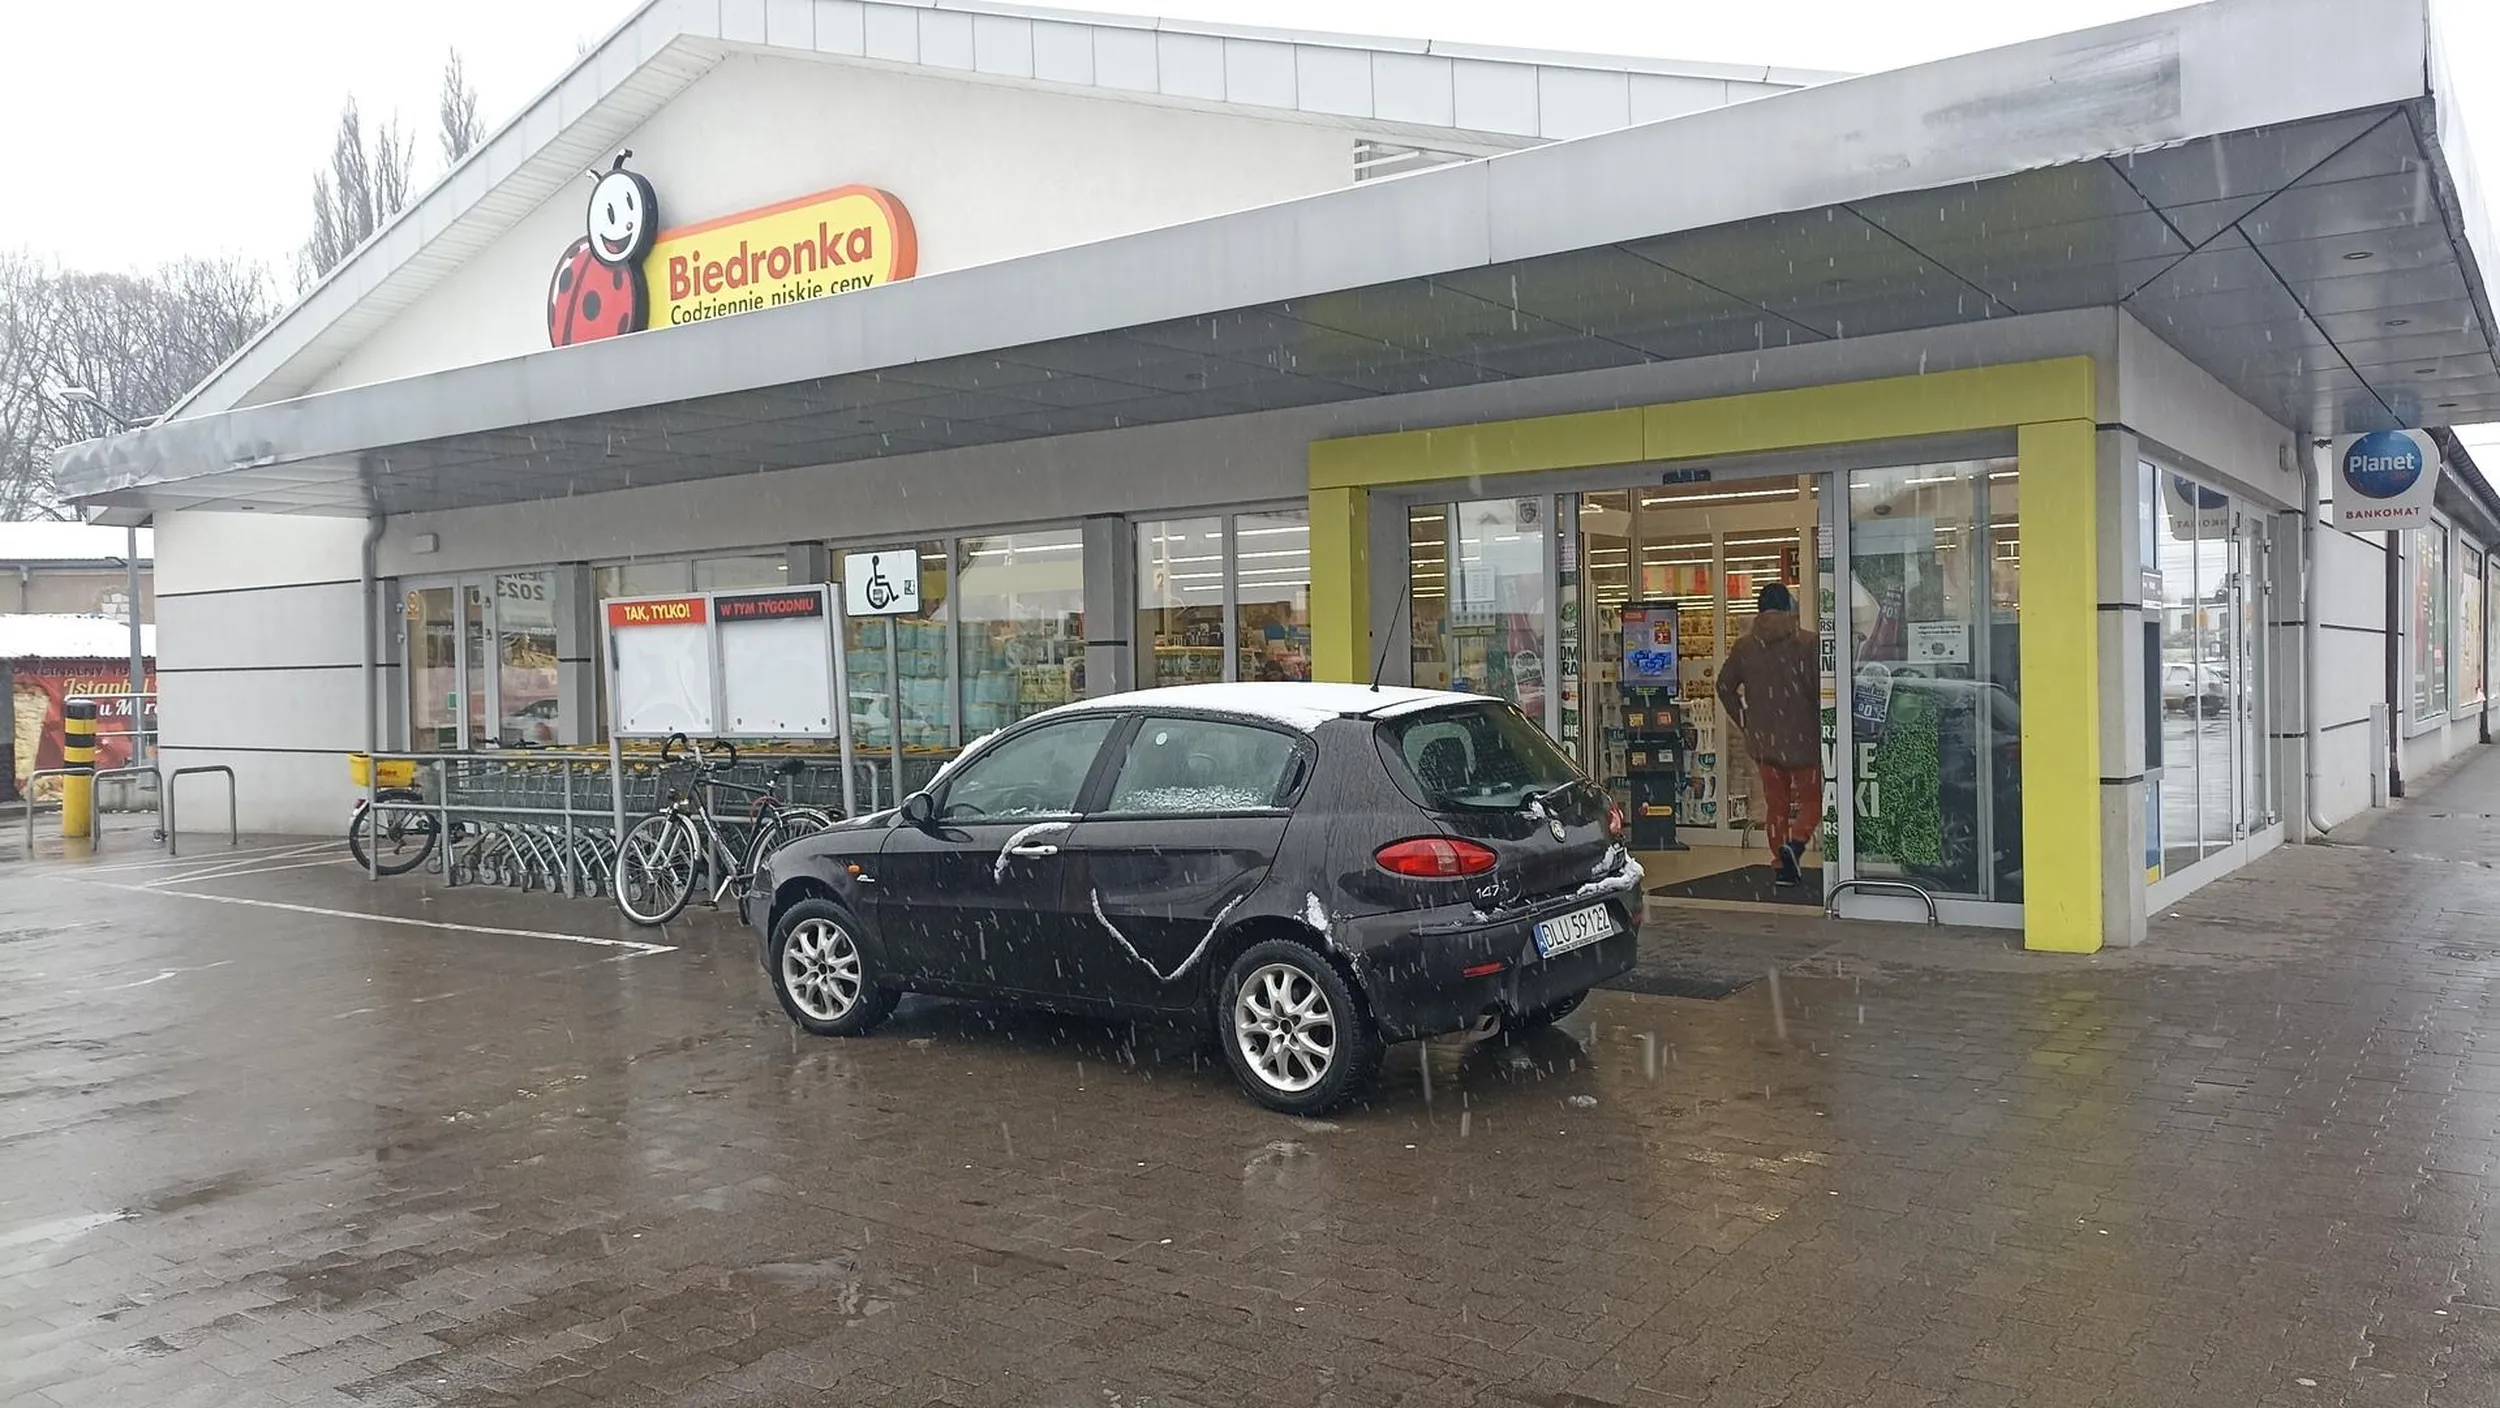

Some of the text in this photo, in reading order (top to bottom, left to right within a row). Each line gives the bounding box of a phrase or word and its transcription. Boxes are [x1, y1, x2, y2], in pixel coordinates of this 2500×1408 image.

[669, 222, 873, 301] Biedronka
[671, 291, 764, 325] Codziennie
[771, 279, 823, 306] niskie
[2349, 452, 2416, 473] Planet
[2345, 507, 2420, 519] BANKOMAT
[624, 603, 691, 622] TAK, TYLKO!
[720, 597, 815, 616] W TYM TYGODNIU
[63, 677, 149, 695] Istanbl
[1476, 885, 1500, 899] 147
[1541, 917, 1571, 948] DLU
[1571, 906, 1610, 938] 59122
